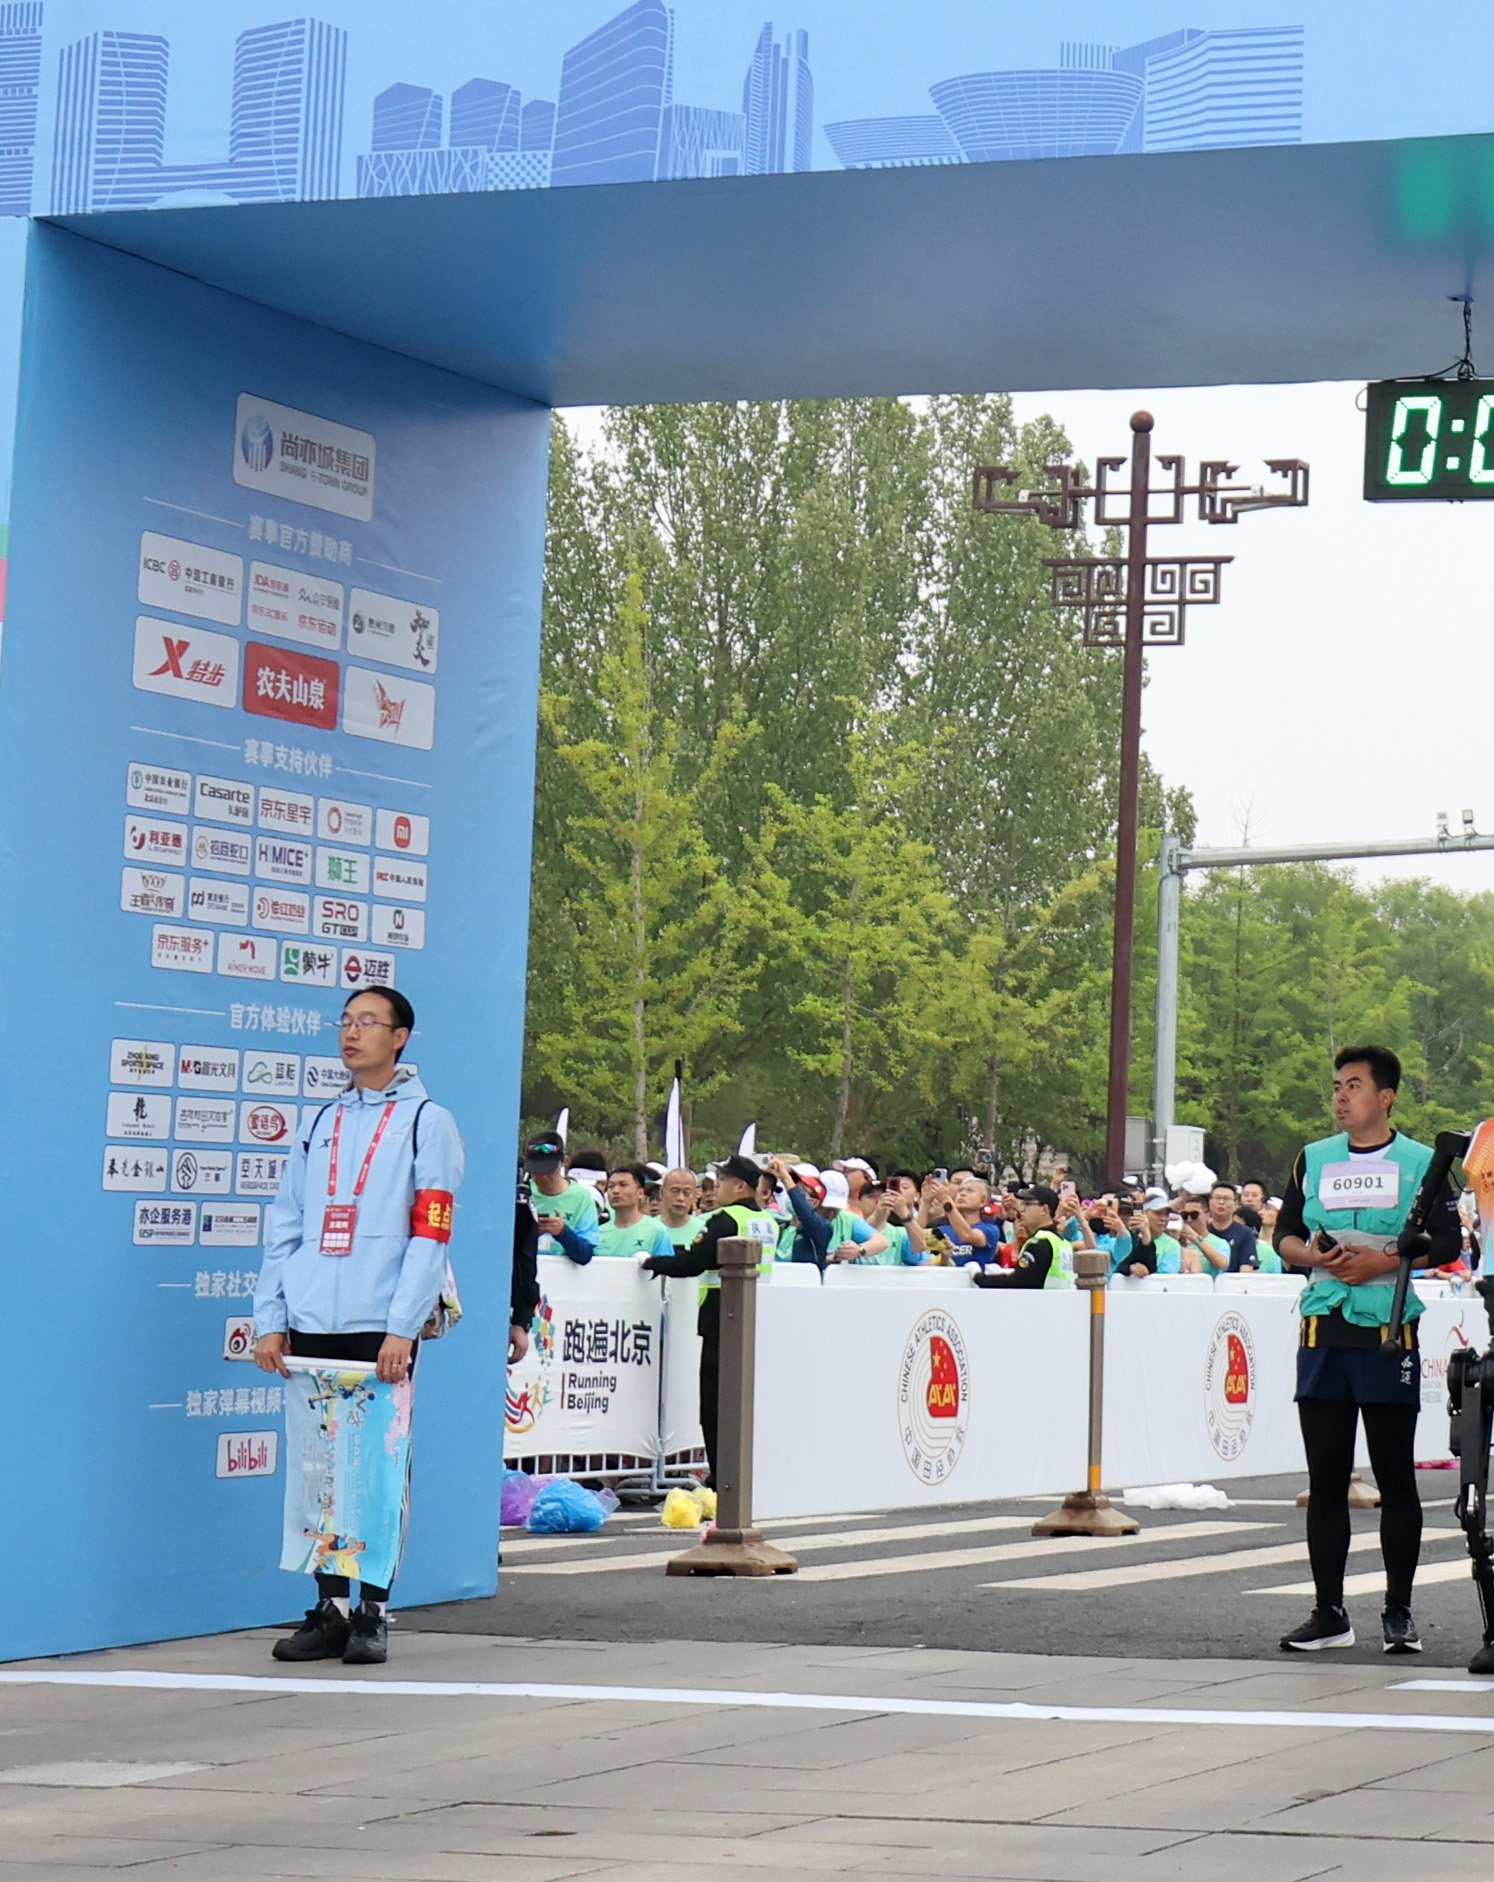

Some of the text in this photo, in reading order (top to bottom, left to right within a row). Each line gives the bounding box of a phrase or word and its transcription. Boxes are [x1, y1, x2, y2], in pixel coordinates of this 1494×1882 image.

[280, 430, 369, 482] 尚亦城集团
[248, 515, 353, 566] 赛事官方赞助商
[143, 557, 166, 574] ICBC
[185, 567, 235, 591] 中国工商银行
[185, 659, 226, 687] 特步
[256, 666, 326, 710] 农夫山泉
[244, 738, 333, 779] 赛事支持伙伴
[145, 773, 188, 790] 中国农业银行
[200, 782, 250, 804] Casarte
[260, 797, 312, 826] 京东星宇
[149, 830, 182, 848] 利亚德
[210, 839, 249, 859] 招商蛇口
[327, 855, 358, 885] 狮王
[390, 873, 424, 887] 中国人民保险
[322, 900, 359, 922] SRO
[322, 921, 341, 936] GT
[302, 950, 332, 979] 蒙牛
[364, 958, 391, 978] 迈胜
[229, 1001, 322, 1037] 官方体验伙伴
[201, 1060, 237, 1078] 晨光文具
[1333, 1176, 1384, 1191] 60901
[139, 1206, 192, 1226] 亦企服务港
[562, 1318, 652, 1366] 跑遍北京
[900, 1315, 968, 1403] CHINESE ATHLETICS ASSOCIATION
[568, 1371, 617, 1393] Running
[186, 1386, 286, 1417] 独家弹幕视频
[567, 1392, 609, 1414] Beijing
[227, 1437, 268, 1473] bilibili
